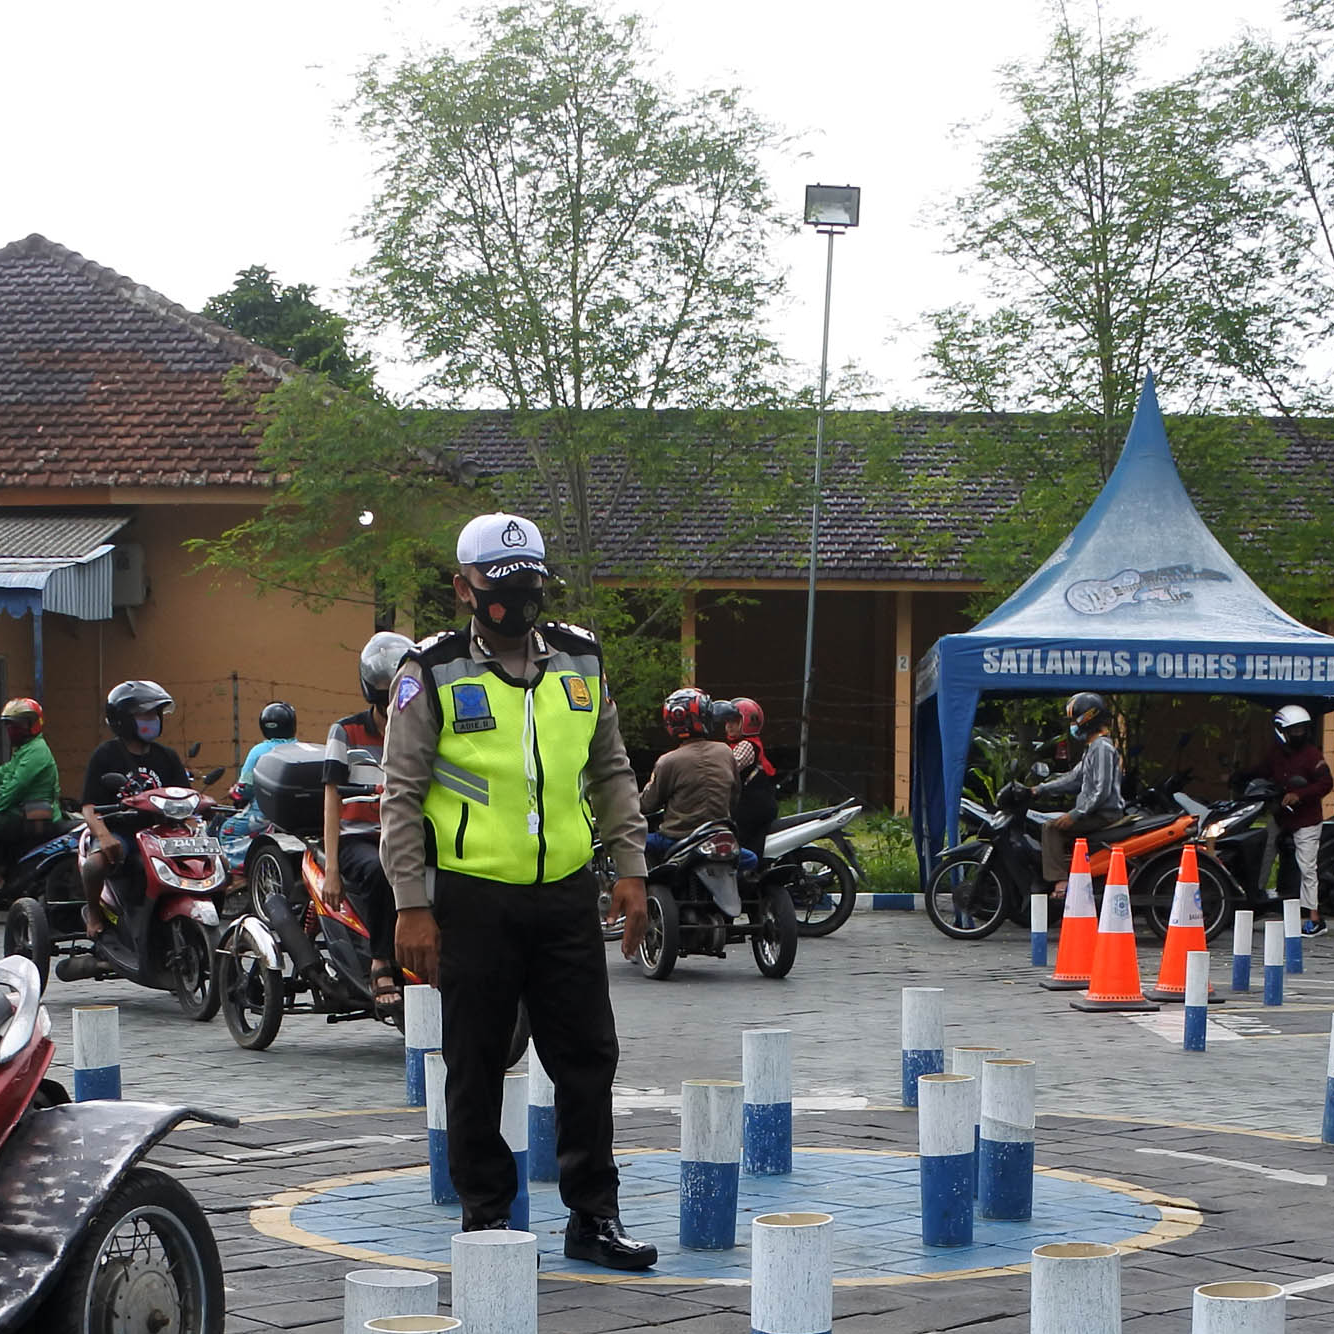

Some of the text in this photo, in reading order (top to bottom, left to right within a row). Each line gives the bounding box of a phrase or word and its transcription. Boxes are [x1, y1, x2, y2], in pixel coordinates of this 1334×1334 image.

[900, 656, 907, 670] 2
[982, 648, 1131, 677] SATLANTAS
[1138, 652, 1237, 681] POLRES
